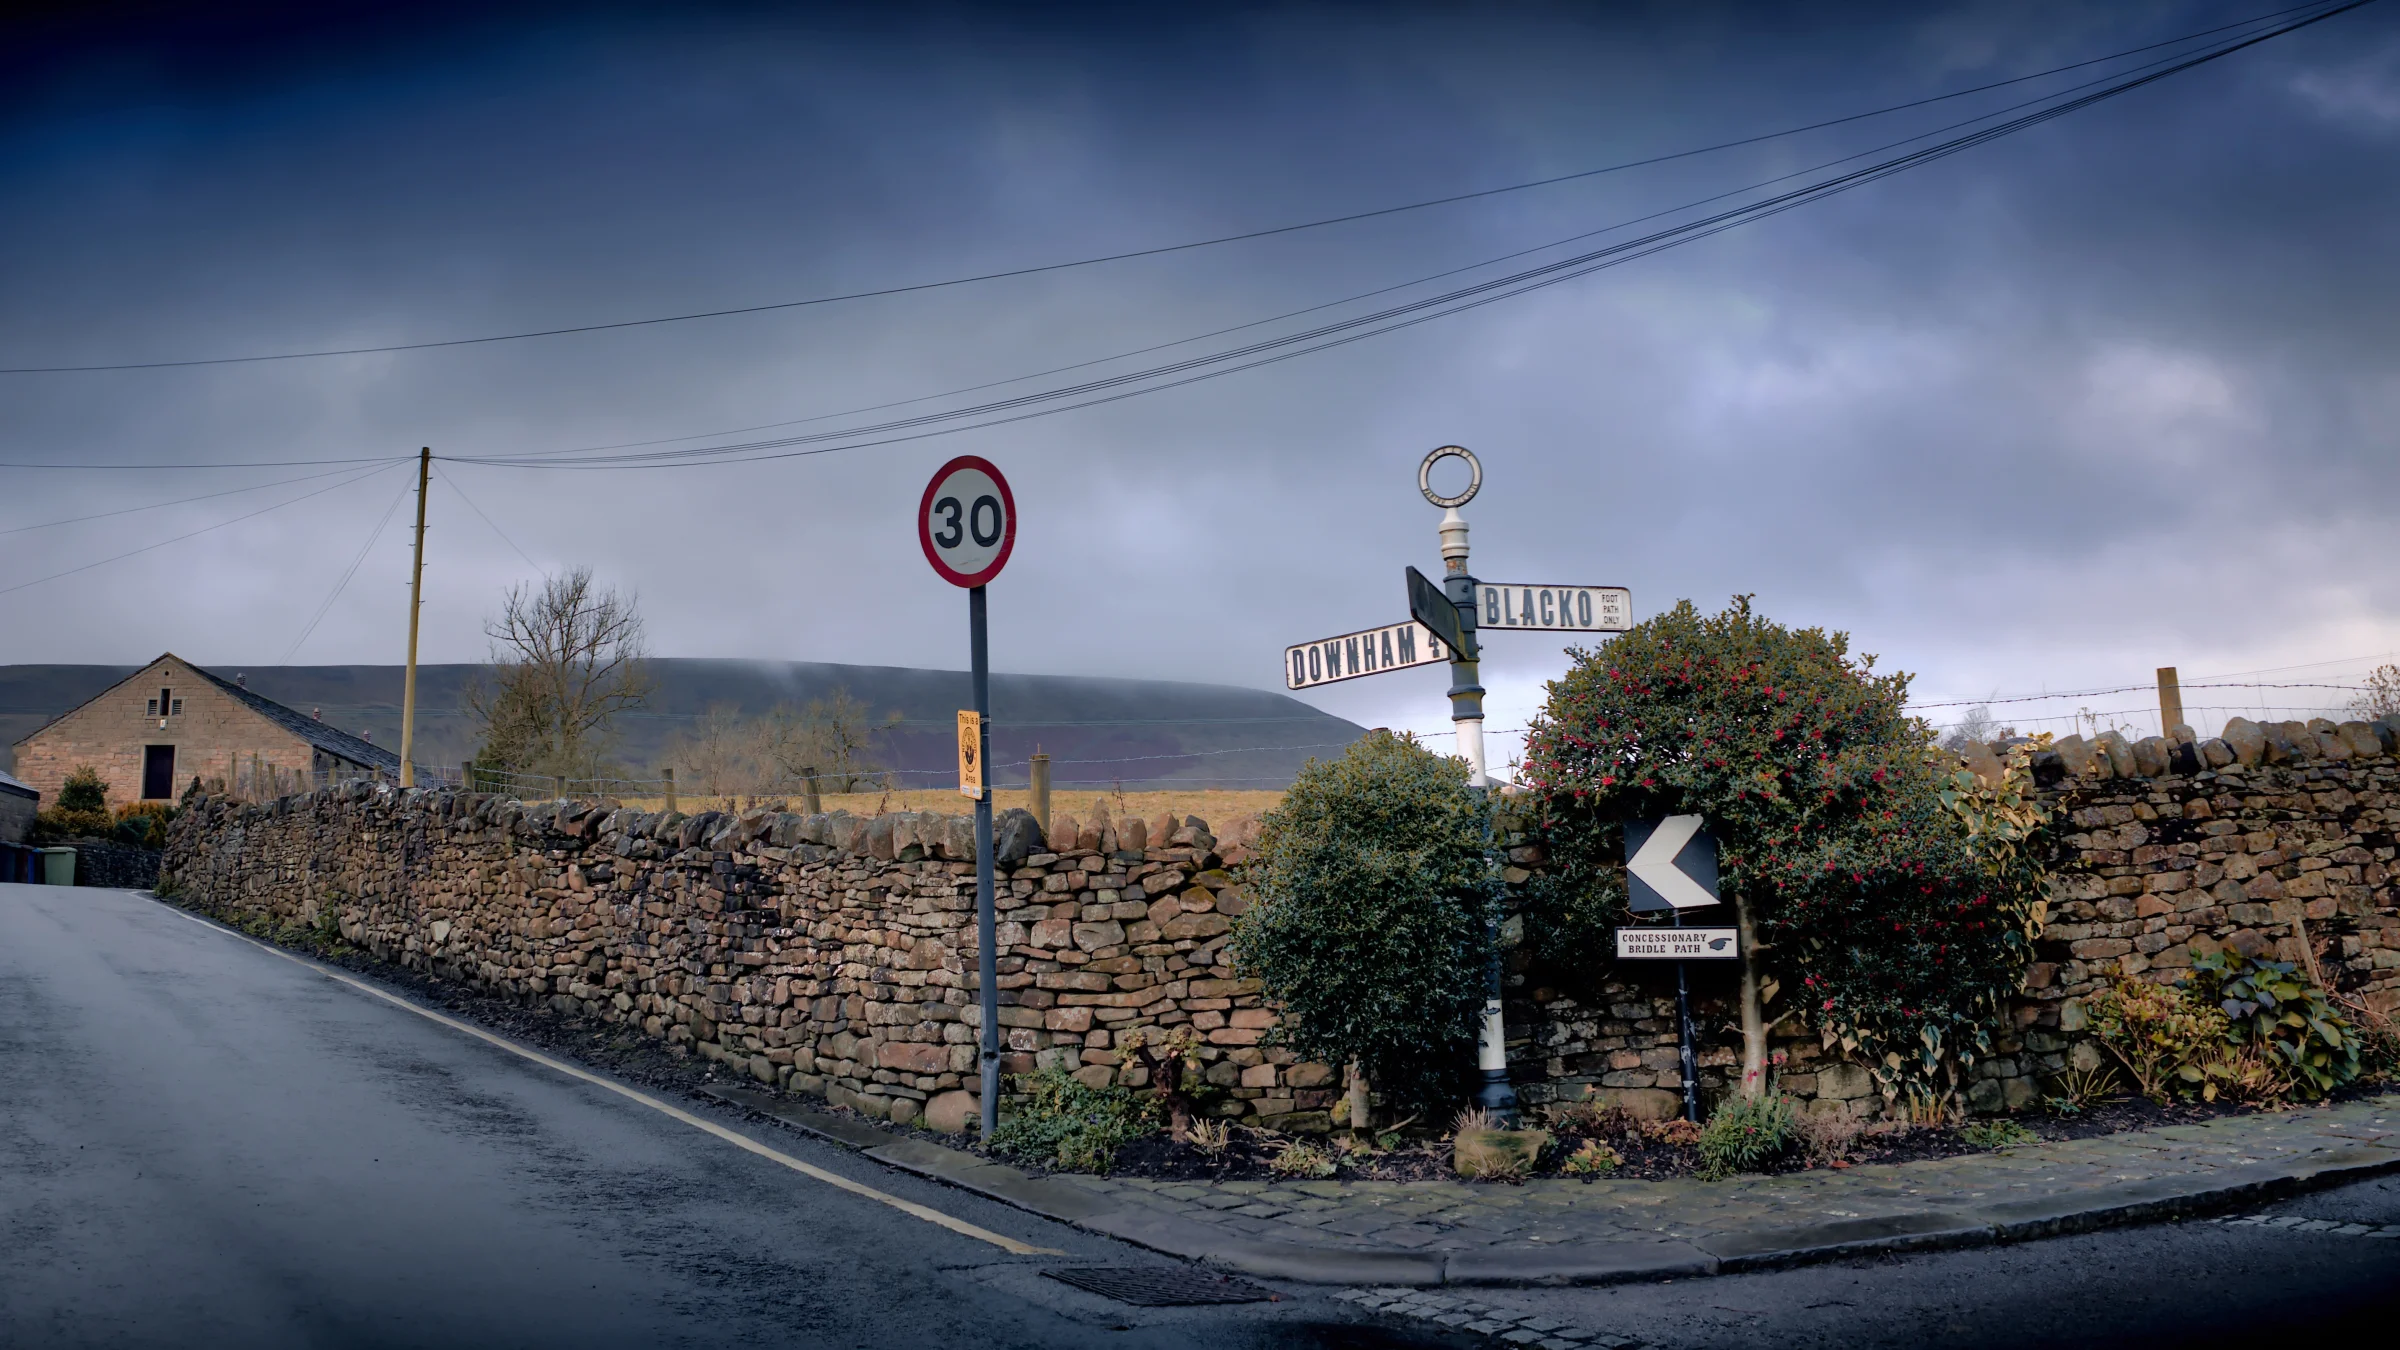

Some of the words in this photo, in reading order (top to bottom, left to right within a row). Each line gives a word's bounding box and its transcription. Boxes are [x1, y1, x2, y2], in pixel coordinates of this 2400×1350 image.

[934, 495, 1003, 549] 30
[1602, 594, 1618, 603] FOOT
[1485, 587, 1592, 627] BLACKO
[1603, 605, 1619, 614] PATH
[1604, 616, 1620, 625] ONLY
[1292, 625, 1416, 686] DOWNHAM
[1428, 630, 1440, 659] 4
[959, 713, 969, 725] This
[1622, 933, 1707, 943] CONCESSIONARY
[1628, 944, 1666, 954] BRIDLE
[1674, 944, 1701, 954] PATH
